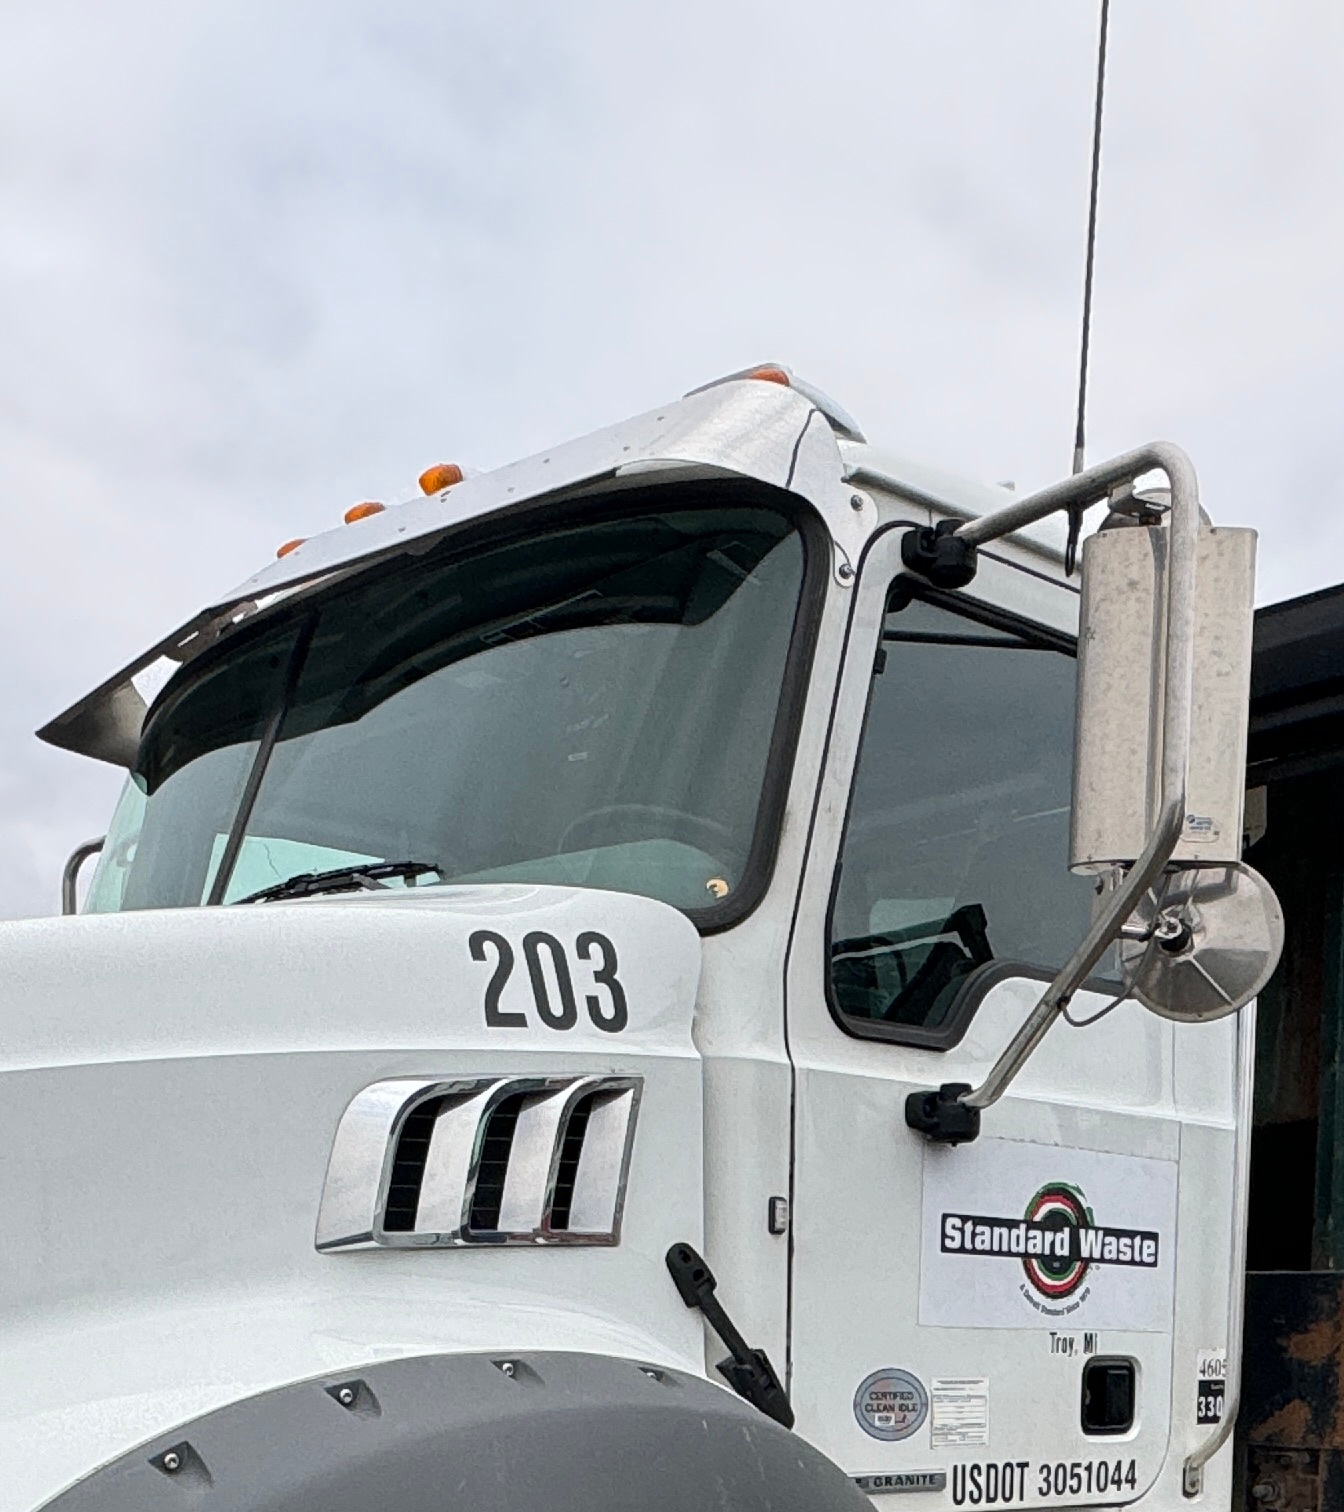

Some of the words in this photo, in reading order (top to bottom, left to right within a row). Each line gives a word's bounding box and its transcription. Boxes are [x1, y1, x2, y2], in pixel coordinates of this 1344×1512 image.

[468, 929, 629, 1034] 203
[944, 1216, 1071, 1257] Standard
[1079, 1228, 1156, 1264] Waste
[1049, 1331, 1078, 1358] Troy,
[864, 1402, 895, 1414] CLEAN
[898, 1402, 918, 1413] IDLE
[1198, 1395, 1223, 1418] 330
[873, 1474, 937, 1488] GRANITE
[952, 1461, 1031, 1506] USDOT
[1038, 1459, 1137, 1497] 3051044
